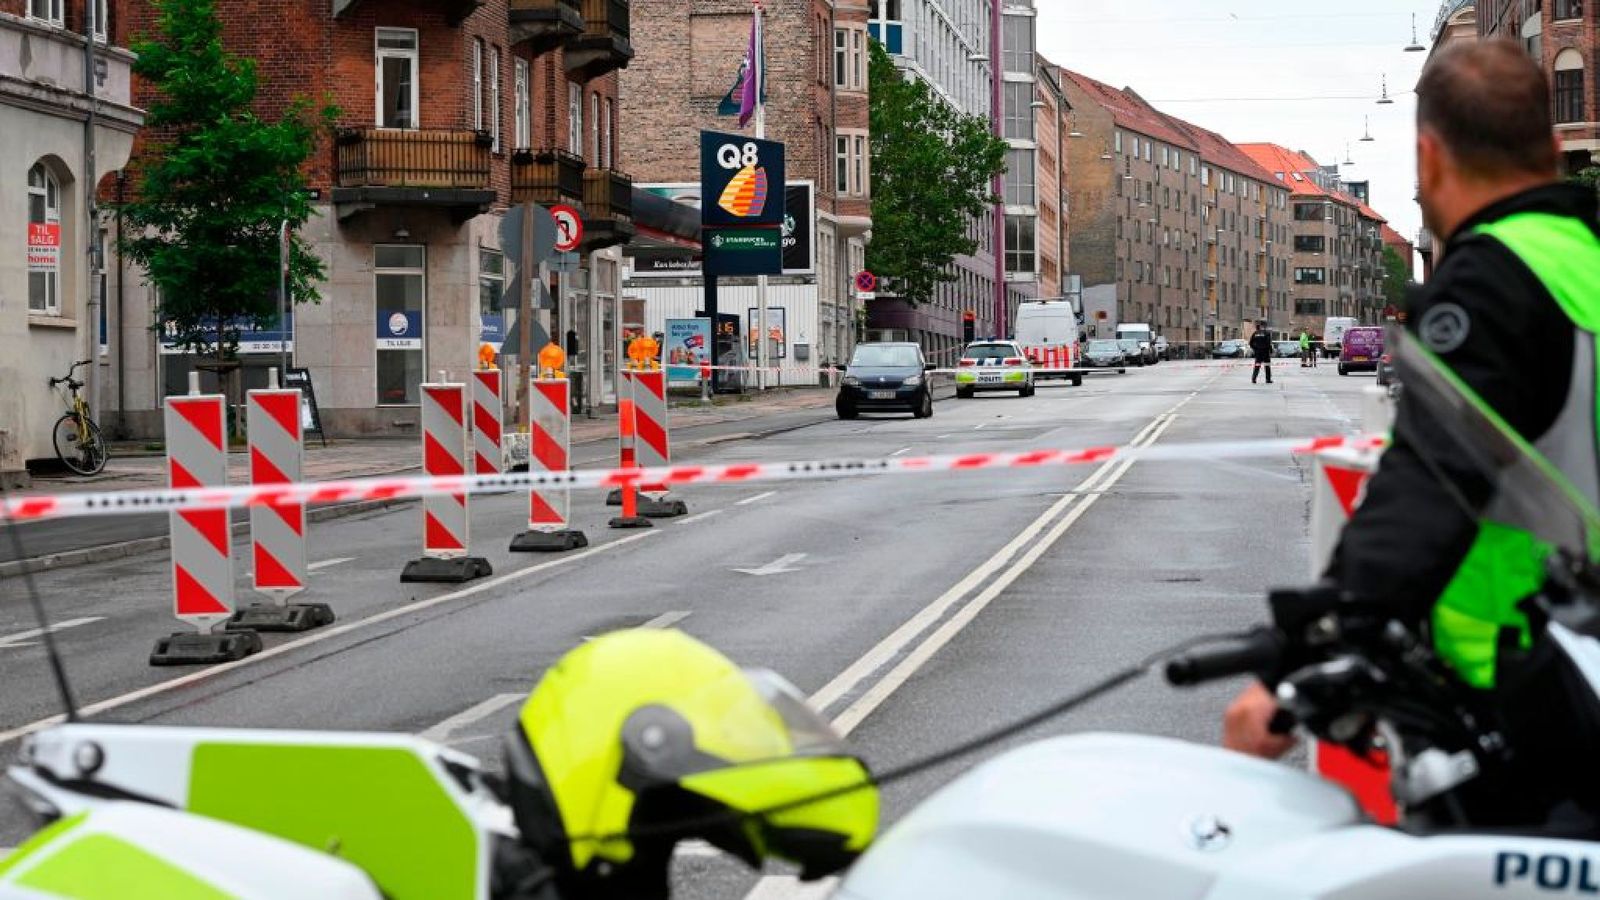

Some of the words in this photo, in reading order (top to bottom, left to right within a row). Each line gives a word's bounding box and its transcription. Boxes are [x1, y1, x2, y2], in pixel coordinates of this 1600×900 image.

[717, 142, 759, 169] Q8
[35, 225, 50, 235] TIL
[31, 235, 54, 245] SALG
[28, 254, 56, 263] home
[1495, 851, 1600, 893] POL
